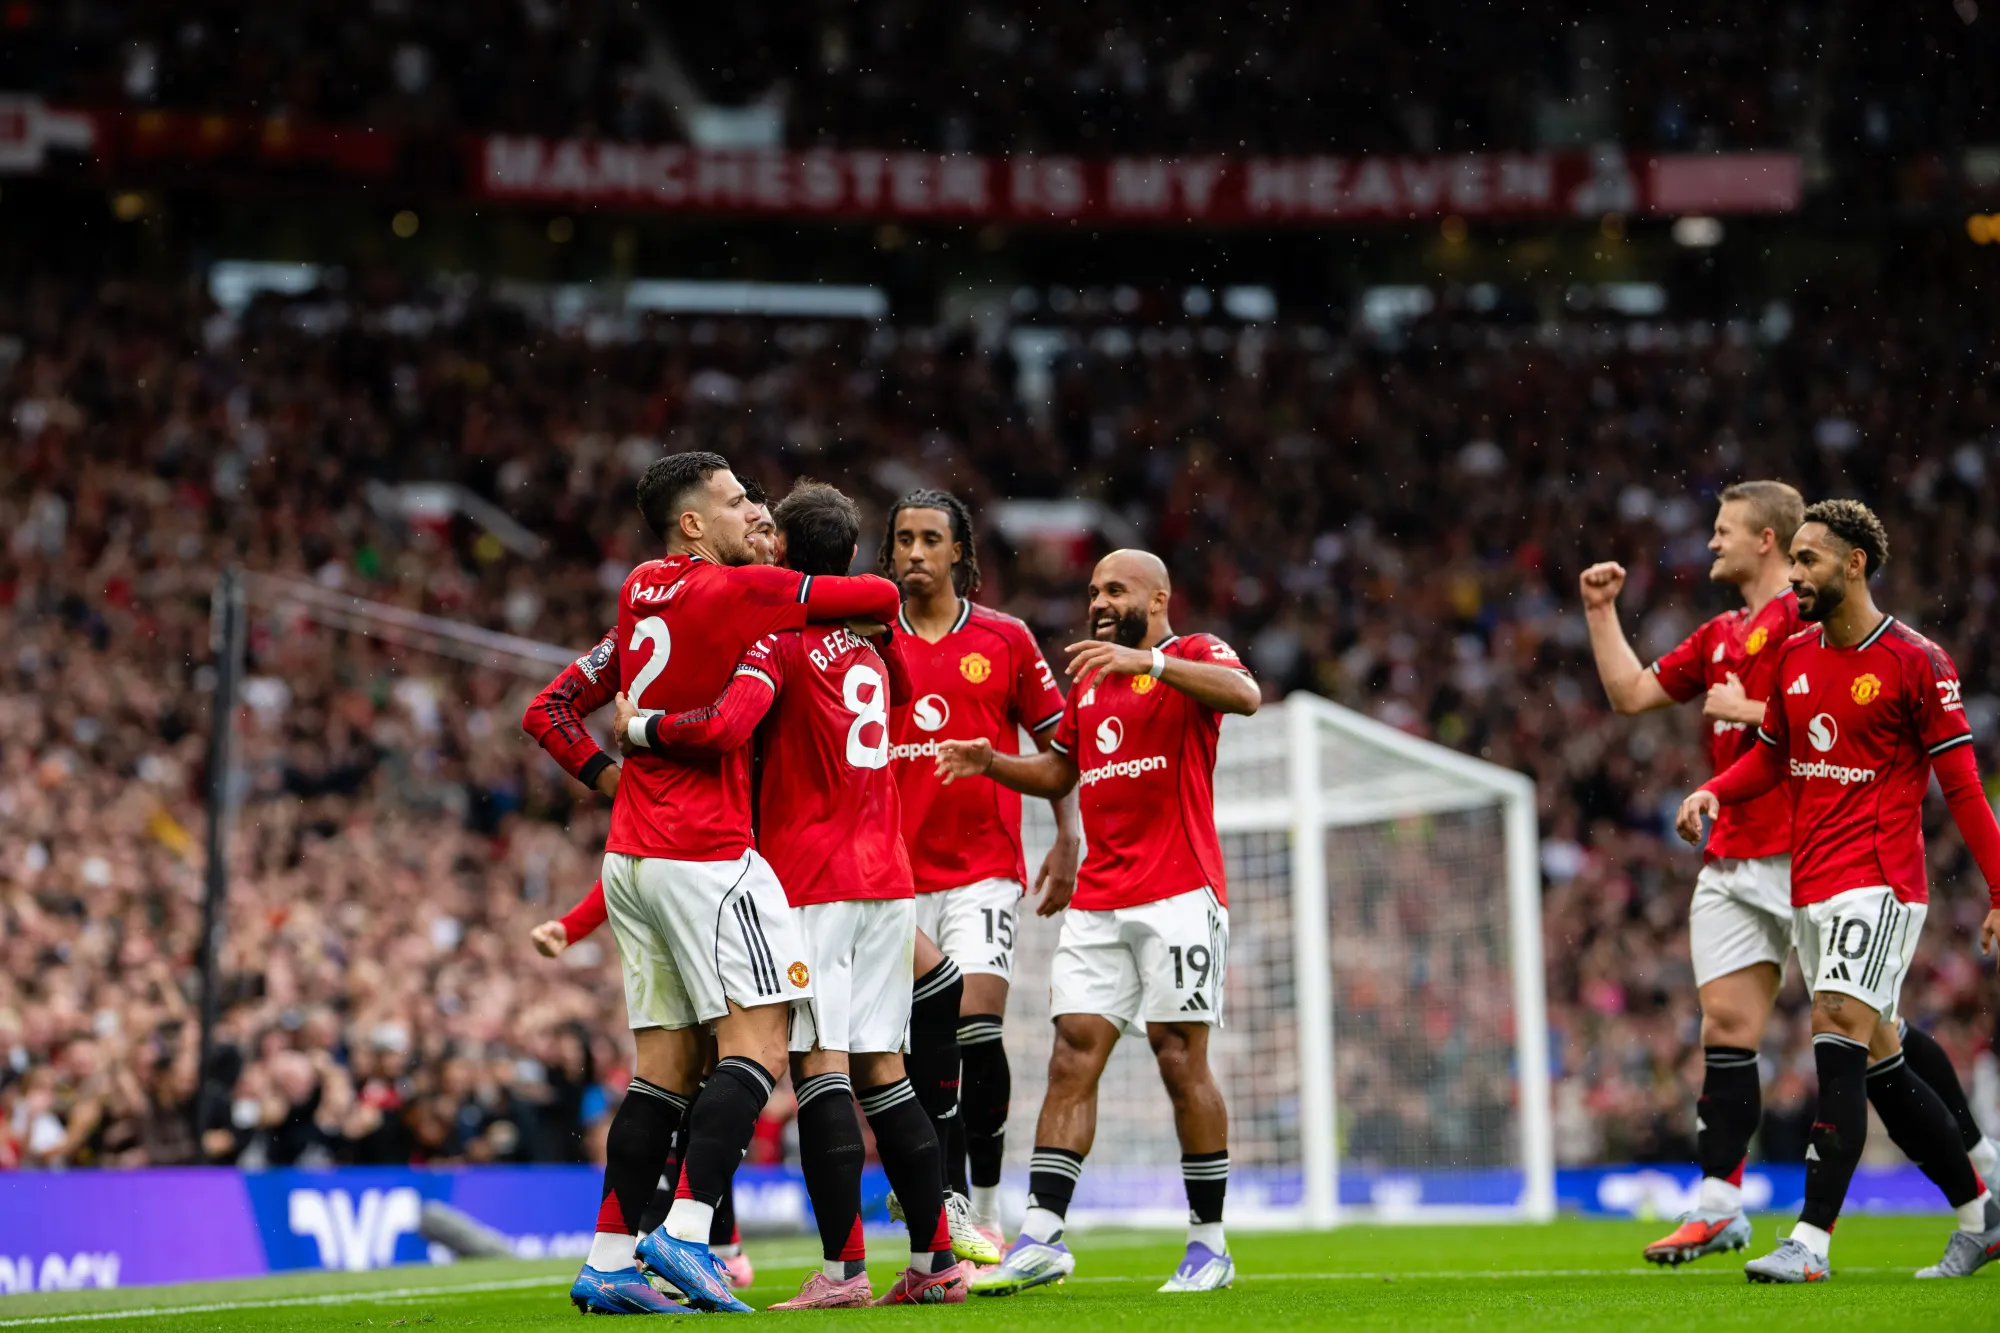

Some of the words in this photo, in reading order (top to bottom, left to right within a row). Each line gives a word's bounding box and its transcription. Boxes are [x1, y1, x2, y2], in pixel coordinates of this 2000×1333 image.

[484, 135, 992, 211] MANCHESTER
[1009, 156, 1085, 213] IS
[1108, 156, 1223, 213] MY
[1246, 152, 1552, 213] HEAVEN
[627, 616, 671, 718] 2
[843, 664, 890, 770] 8
[1790, 757, 1876, 786] Sapdragon
[980, 908, 1013, 950] 15
[1826, 915, 1872, 960] 10
[1169, 944, 1211, 989] 19
